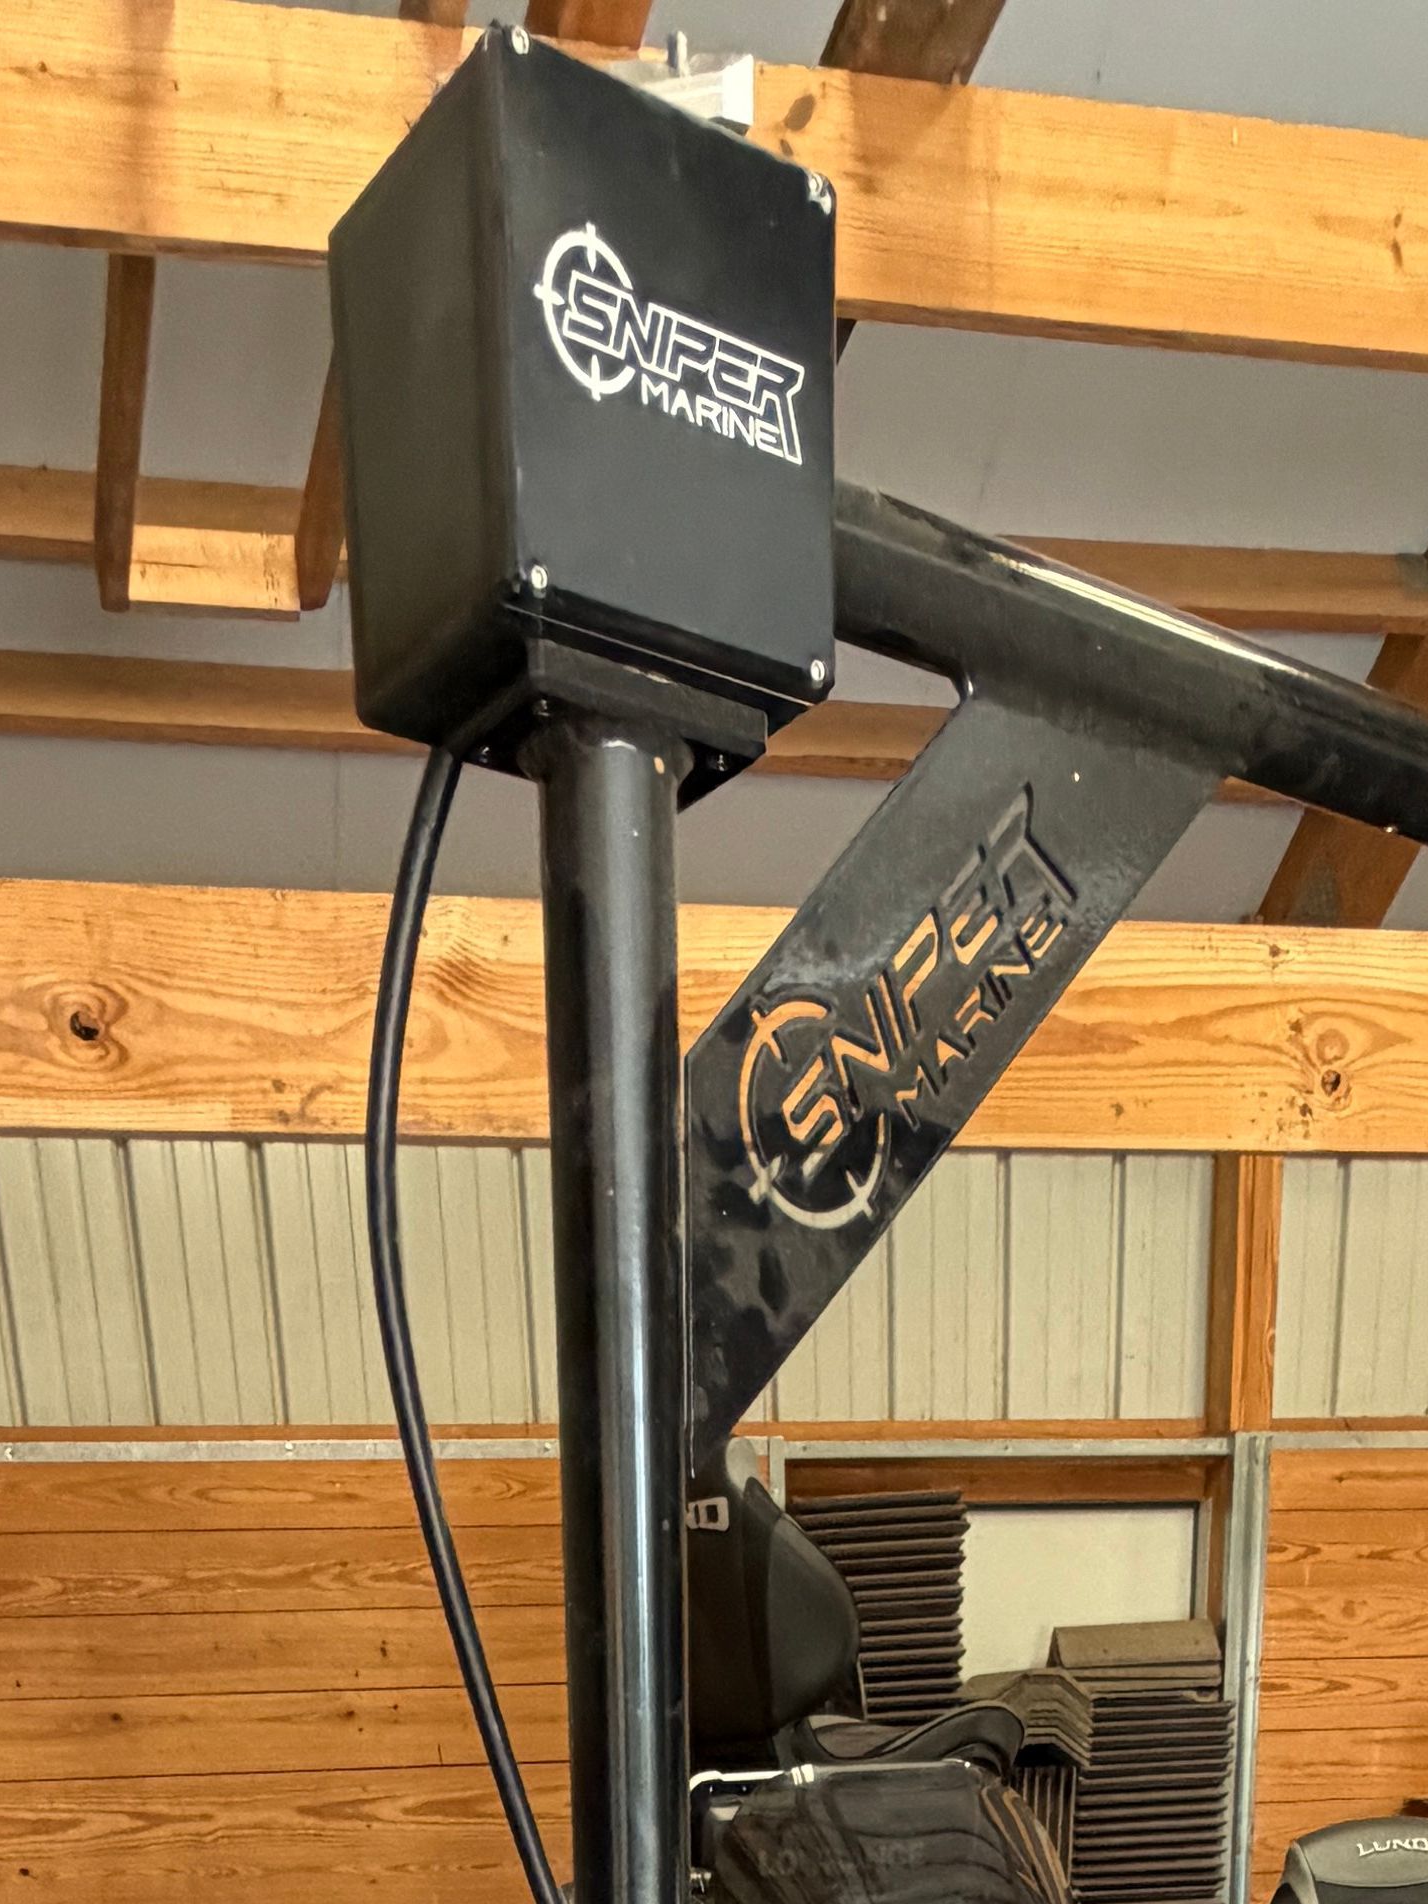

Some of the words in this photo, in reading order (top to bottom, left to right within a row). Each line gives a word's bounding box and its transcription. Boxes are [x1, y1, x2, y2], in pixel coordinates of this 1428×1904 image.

[562, 268, 805, 466] SNIPER
[640, 373, 783, 457] MARINE
[781, 781, 1077, 1178] SNIPER
[895, 900, 1069, 1132] MARINE
